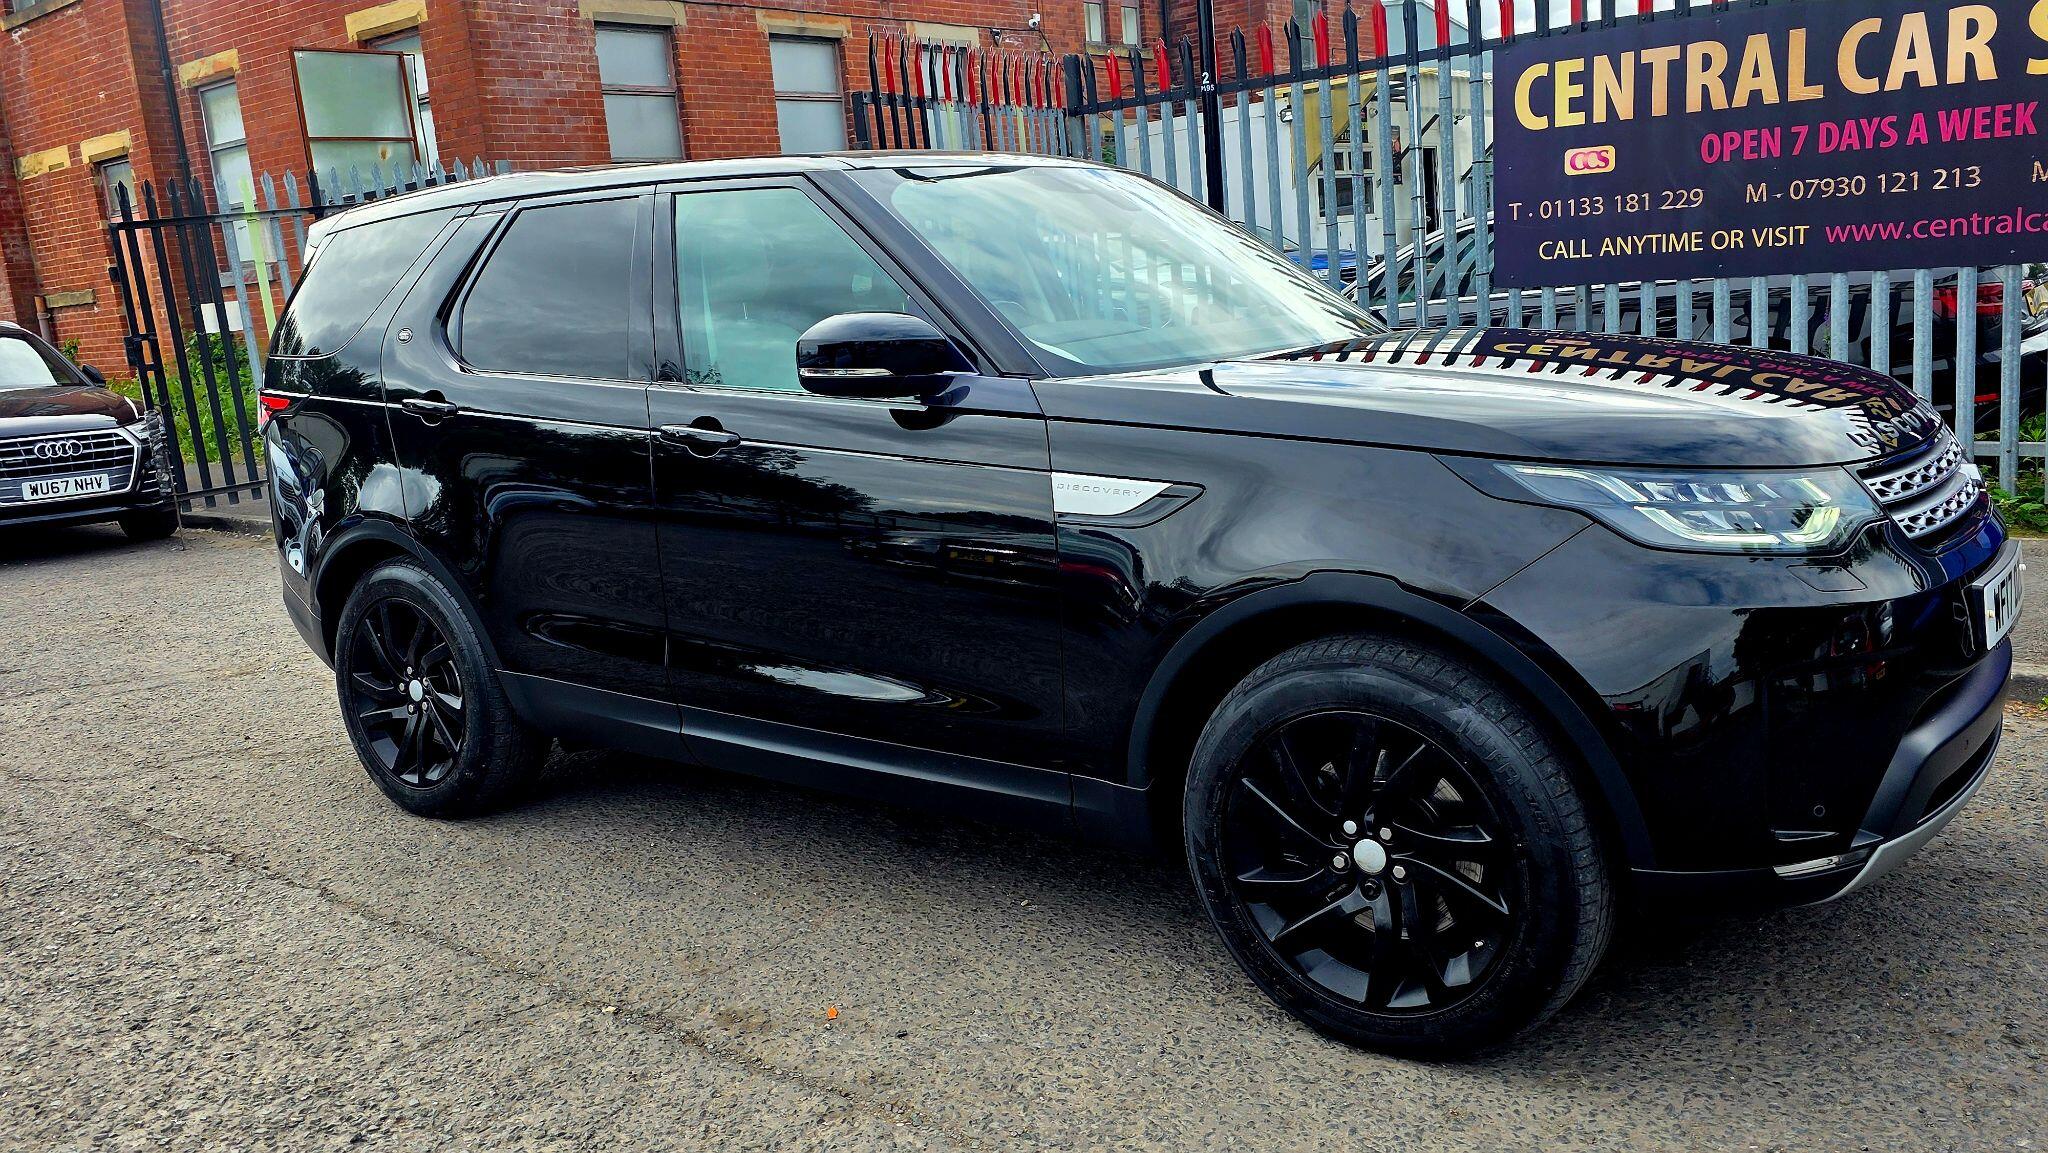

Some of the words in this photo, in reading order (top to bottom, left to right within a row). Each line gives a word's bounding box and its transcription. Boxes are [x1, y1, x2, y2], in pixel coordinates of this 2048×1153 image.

[1201, 71, 1210, 85] 2
[1514, 28, 1824, 131] CENTRAL
[1837, 5, 1998, 95] CAR
[1701, 127, 1781, 164] OPEN
[1791, 125, 1809, 156] 7
[1818, 116, 1898, 154] DAYS
[1906, 112, 1929, 146] A
[1937, 101, 2038, 143] WEEK
[1569, 150, 1609, 171] CCS
[1789, 174, 1866, 201] 07930
[1877, 170, 1919, 194] 121
[1932, 165, 1982, 190] 213
[1614, 191, 1650, 213] 181
[1659, 188, 1704, 211] 229
[1538, 238, 1592, 261] CALL
[1599, 231, 1703, 258] ANYTIME
[1711, 229, 1744, 250] OR
[1751, 225, 1810, 248] VISIT
[29, 480, 70, 497] WU67
[74, 476, 103, 492] NHV
[1056, 483, 1142, 498] DISCOVERY
